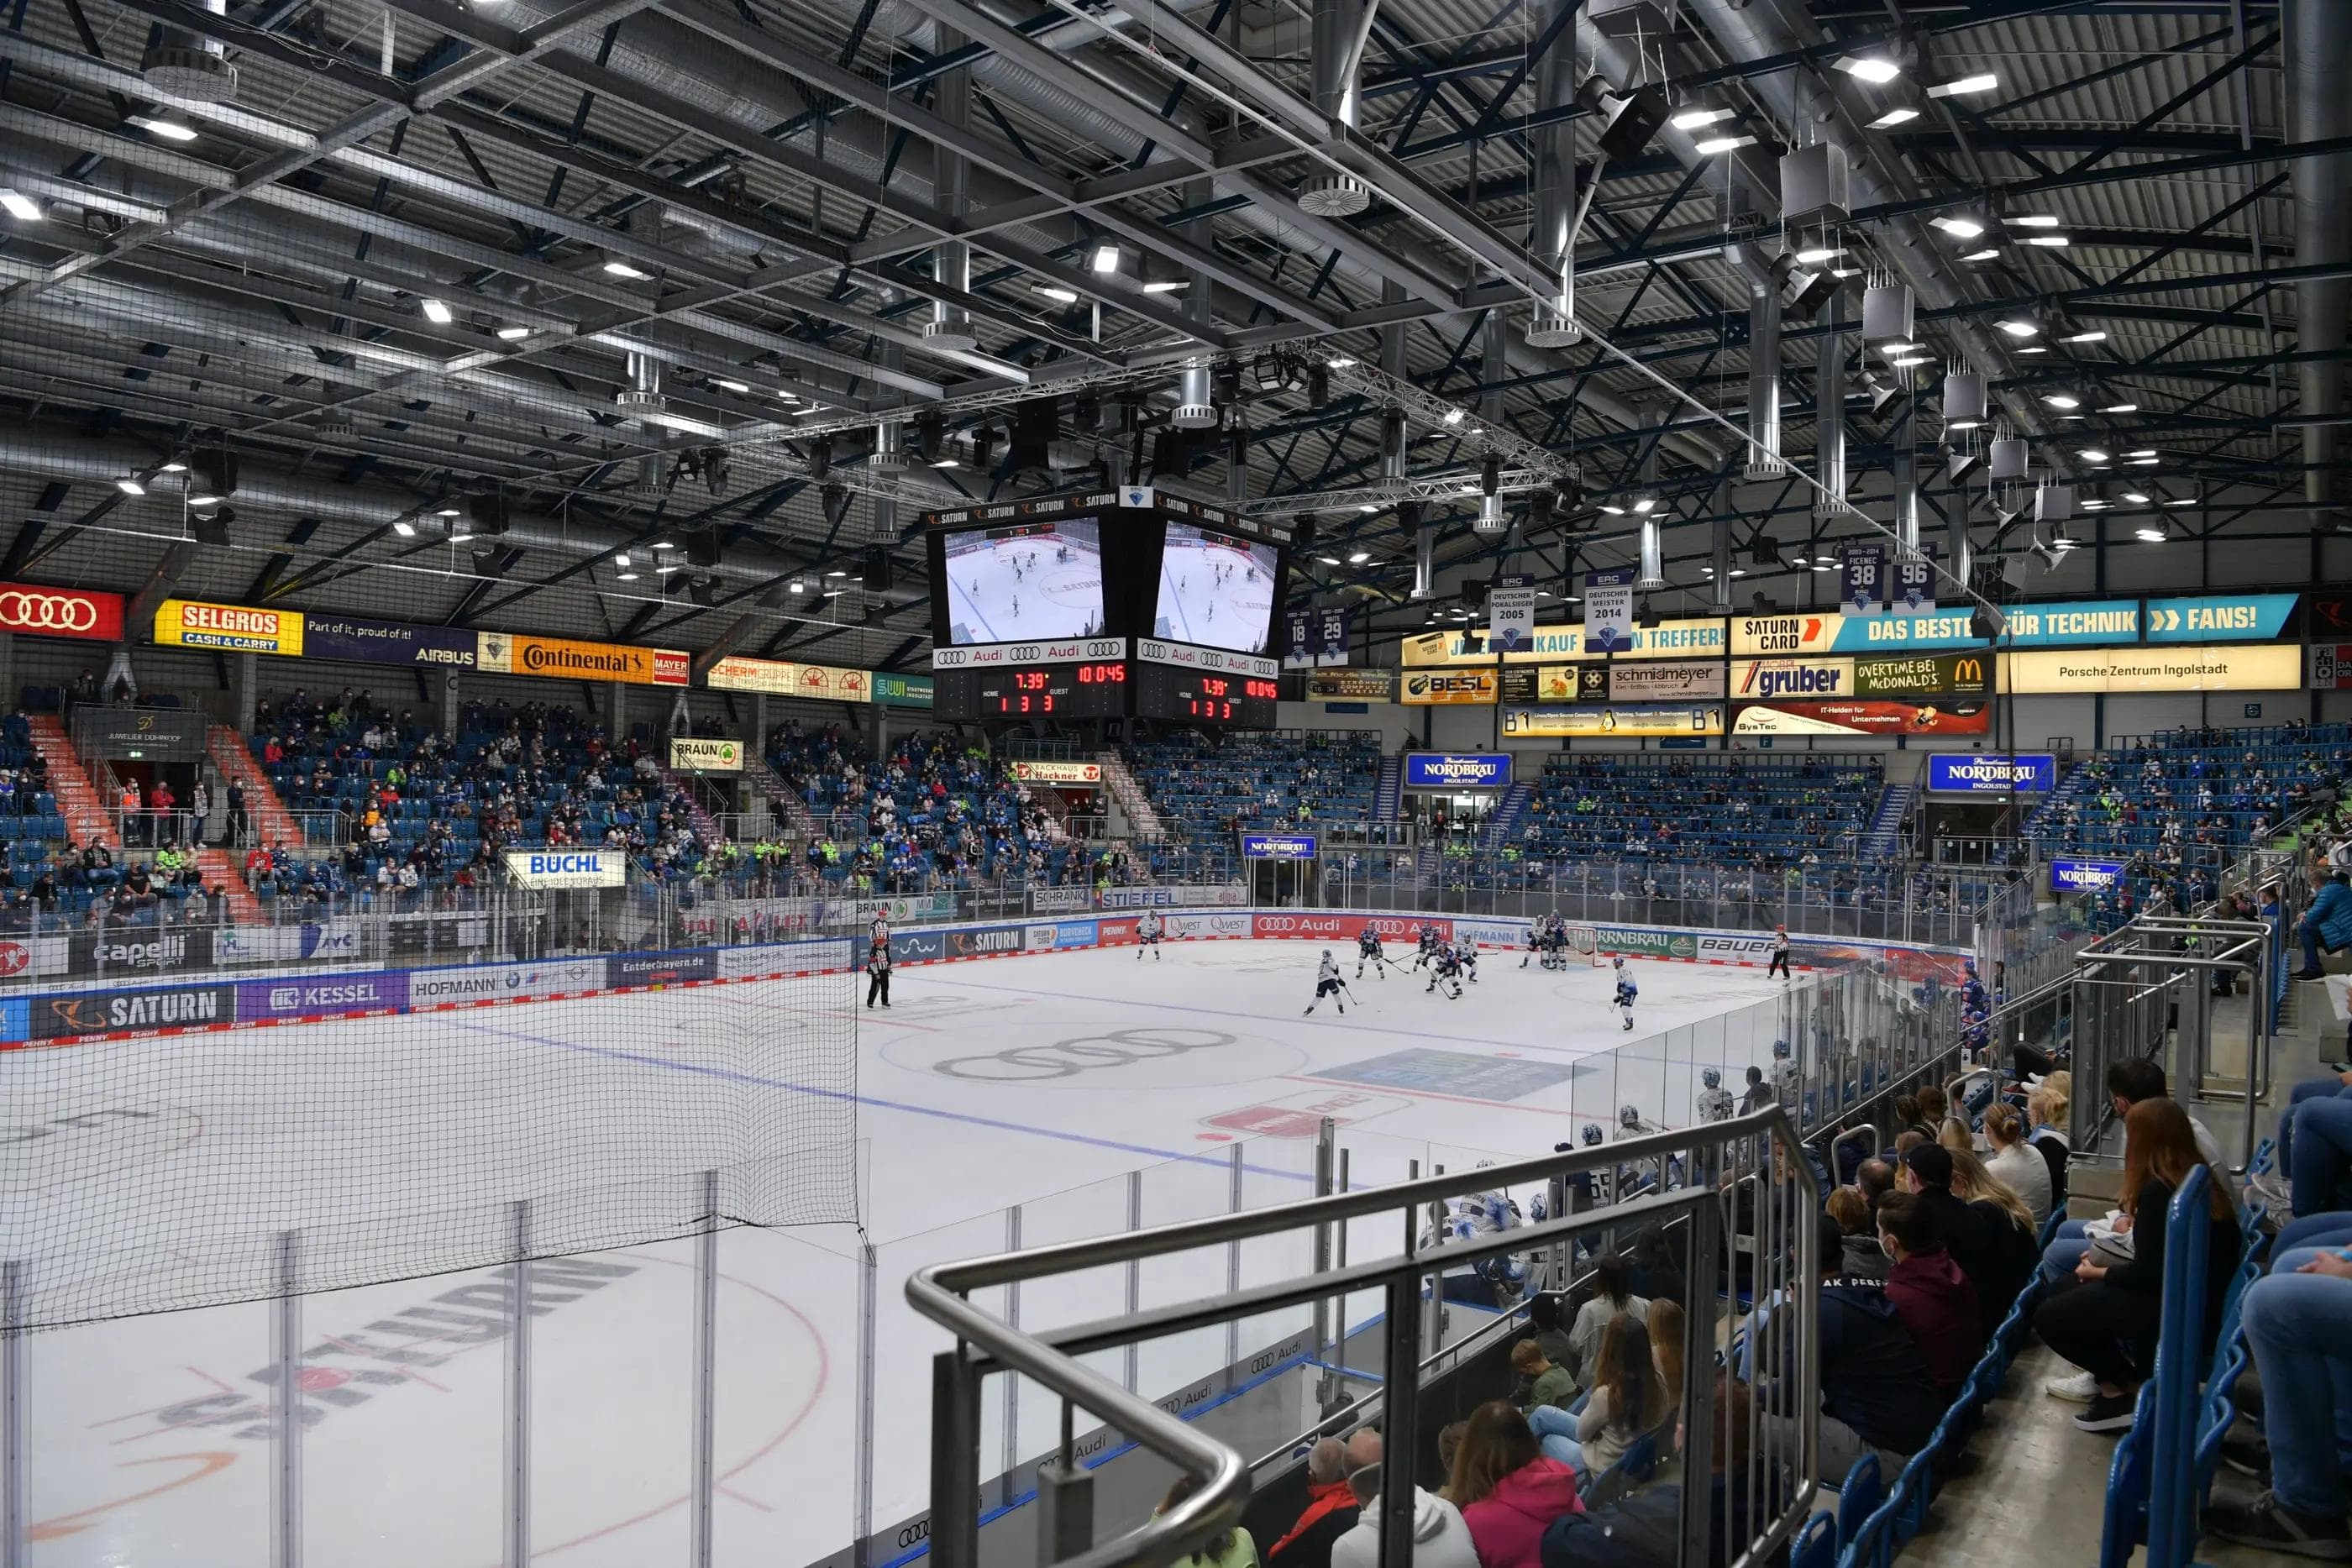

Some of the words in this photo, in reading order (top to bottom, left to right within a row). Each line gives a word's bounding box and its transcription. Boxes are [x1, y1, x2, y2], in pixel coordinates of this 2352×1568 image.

[1035, 500, 1064, 513] SATURN
[1085, 493, 1116, 507] SATURN
[1166, 498, 1189, 513] SATURN
[941, 511, 968, 524] SATURN
[987, 506, 1015, 519] SATURN
[1203, 508, 1225, 523] SATURN
[1237, 518, 1258, 532] SATURN
[1272, 527, 1291, 543] SATURN
[1598, 575, 1620, 584] ERC
[1850, 565, 1875, 585] 38
[1902, 564, 1928, 584] 96
[1589, 590, 1629, 599] DEUTSCHER
[1491, 600, 1534, 608] POKALSIEGER
[1593, 599, 1625, 607] MEISTER
[184, 606, 277, 634] SELGROS
[1499, 611, 1525, 620] 2005
[1595, 609, 1622, 619] 2014
[2187, 606, 2257, 630] FANS!
[308, 621, 329, 632] Part
[332, 623, 344, 633] of
[344, 624, 354, 636] it,
[357, 627, 387, 639] proud
[390, 629, 401, 639] of
[401, 629, 412, 640] it!
[1324, 622, 1341, 640] 29
[1746, 619, 1799, 636] SATURN
[1868, 621, 1908, 641] DAS
[1914, 616, 1971, 640] BESTE
[2001, 610, 2040, 636] FÜR
[2045, 611, 2136, 634] TECHNIK
[1292, 625, 1305, 642] 18
[1651, 627, 1725, 648] TREFFER!
[186, 633, 221, 646] CASH
[223, 637, 232, 647] &
[234, 637, 276, 650] CARRY
[1761, 635, 1798, 650] CARD
[415, 648, 475, 665] AIRBUS
[523, 643, 628, 672] Continental
[974, 650, 1002, 662] Audi
[1048, 645, 1079, 658] Audi
[1171, 649, 1195, 663] Audi
[655, 659, 687, 670] MAYER
[1227, 658, 1249, 670] Audi
[2060, 664, 2107, 678] Porsche
[2109, 663, 2161, 678] Zentrum
[2165, 662, 2229, 679] Ingolstadt
[448, 676, 457, 690] C
[1431, 676, 1492, 691] BESL
[1616, 667, 1713, 686] schmidmeyer
[1760, 665, 1840, 697] gruber
[1001, 698, 1007, 711] 1
[1021, 696, 1029, 711] 3
[1044, 695, 1052, 711] 3
[1206, 701, 1214, 717] 3
[1223, 703, 1230, 718] 3
[108, 732, 143, 741] JUWELIER
[677, 743, 717, 755] BRAUN
[1035, 770, 1079, 780] Hackner
[1424, 763, 1496, 778] NORDBRÄU
[530, 854, 603, 874] BÜCHL
[966, 899, 985, 907] HELLO!
[1103, 892, 1179, 908] STIEFEL
[857, 901, 892, 915] BRAUN
[1299, 919, 1340, 931] Audi
[975, 931, 1019, 952] SATURN
[93, 934, 186, 966] capelli
[136, 956, 185, 968] SPORT
[305, 983, 381, 1006] KESSEL
[415, 977, 496, 997] HOFMANN
[110, 991, 217, 1027] SATURN
[1278, 1340, 1302, 1362] Audi
[1184, 1383, 1212, 1408] Audi
[1074, 1433, 1106, 1462] Audi
